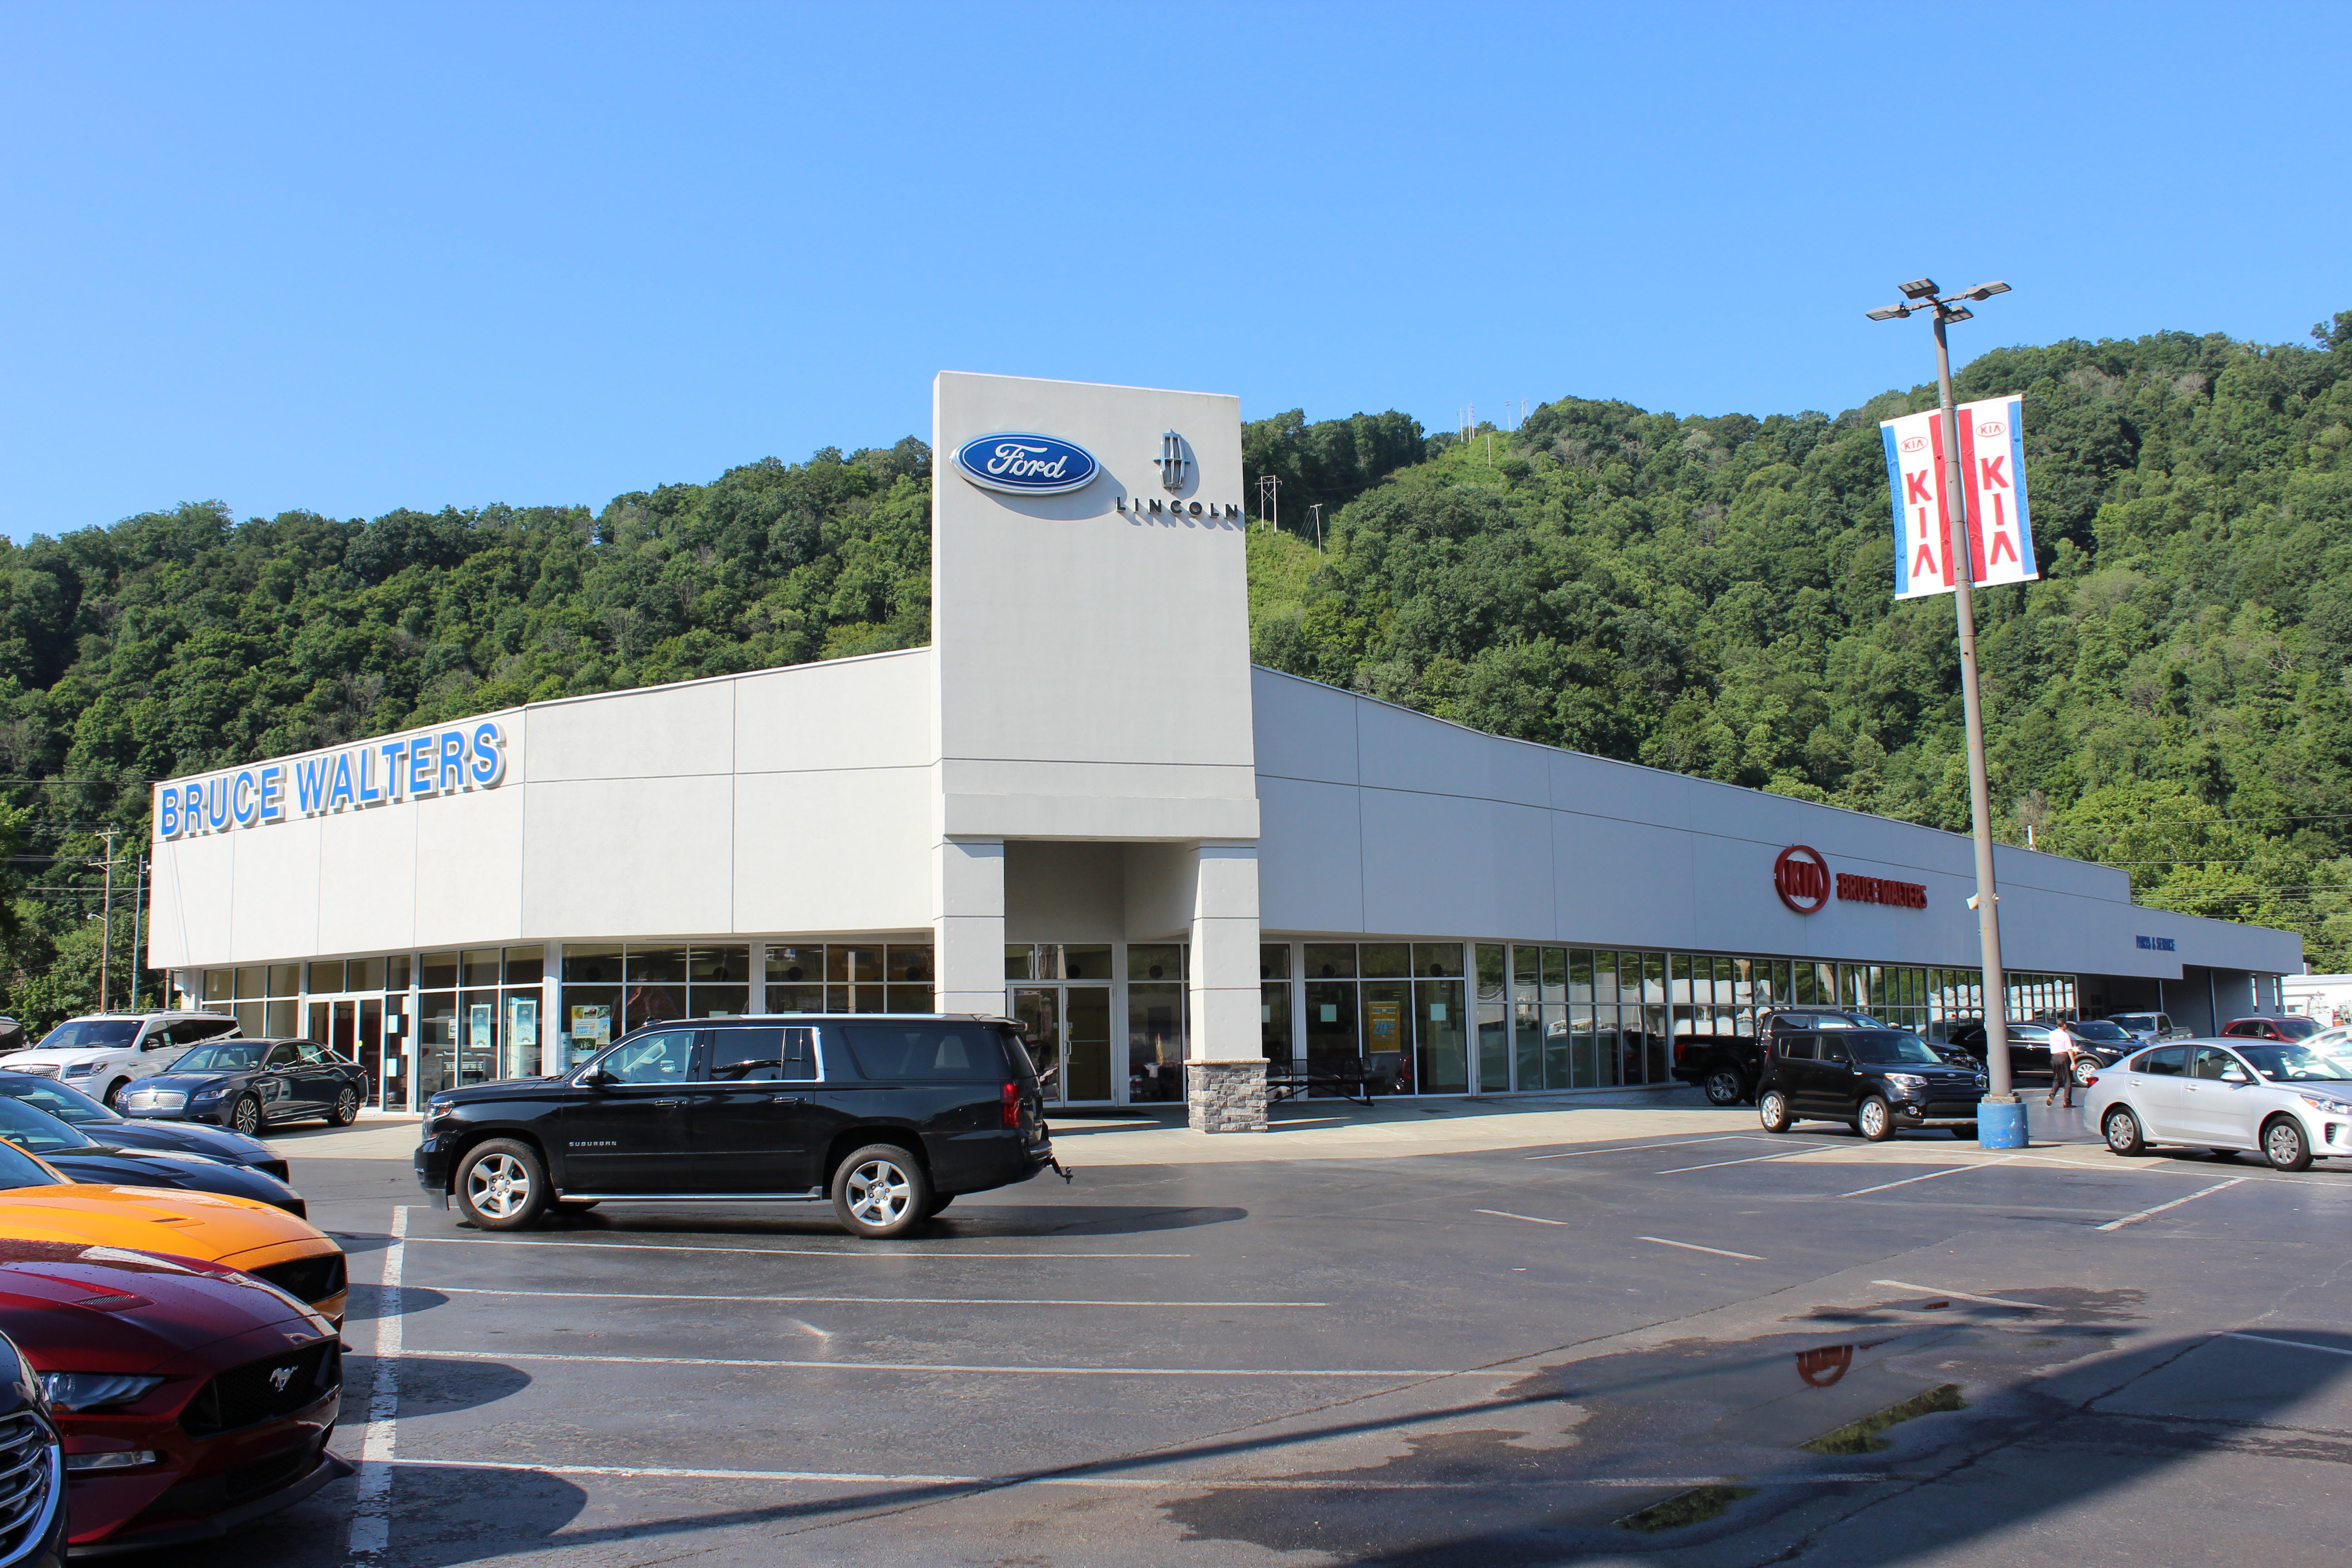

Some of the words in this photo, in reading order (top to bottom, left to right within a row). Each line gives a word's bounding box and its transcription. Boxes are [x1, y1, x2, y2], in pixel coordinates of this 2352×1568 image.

[1904, 439, 1924, 450] KIA
[1980, 425, 2001, 435] KIA
[988, 443, 1068, 478] Ford
[1116, 497, 1238, 519] LINCOLN
[1906, 469, 1938, 578] KIA
[1980, 455, 2018, 565] KIA
[160, 764, 286, 839] BRUCE
[295, 721, 506, 815] WALTERS
[1785, 859, 1823, 899] KIA
[1836, 873, 1879, 903] BRUCE
[1879, 878, 1928, 909] WALTERS
